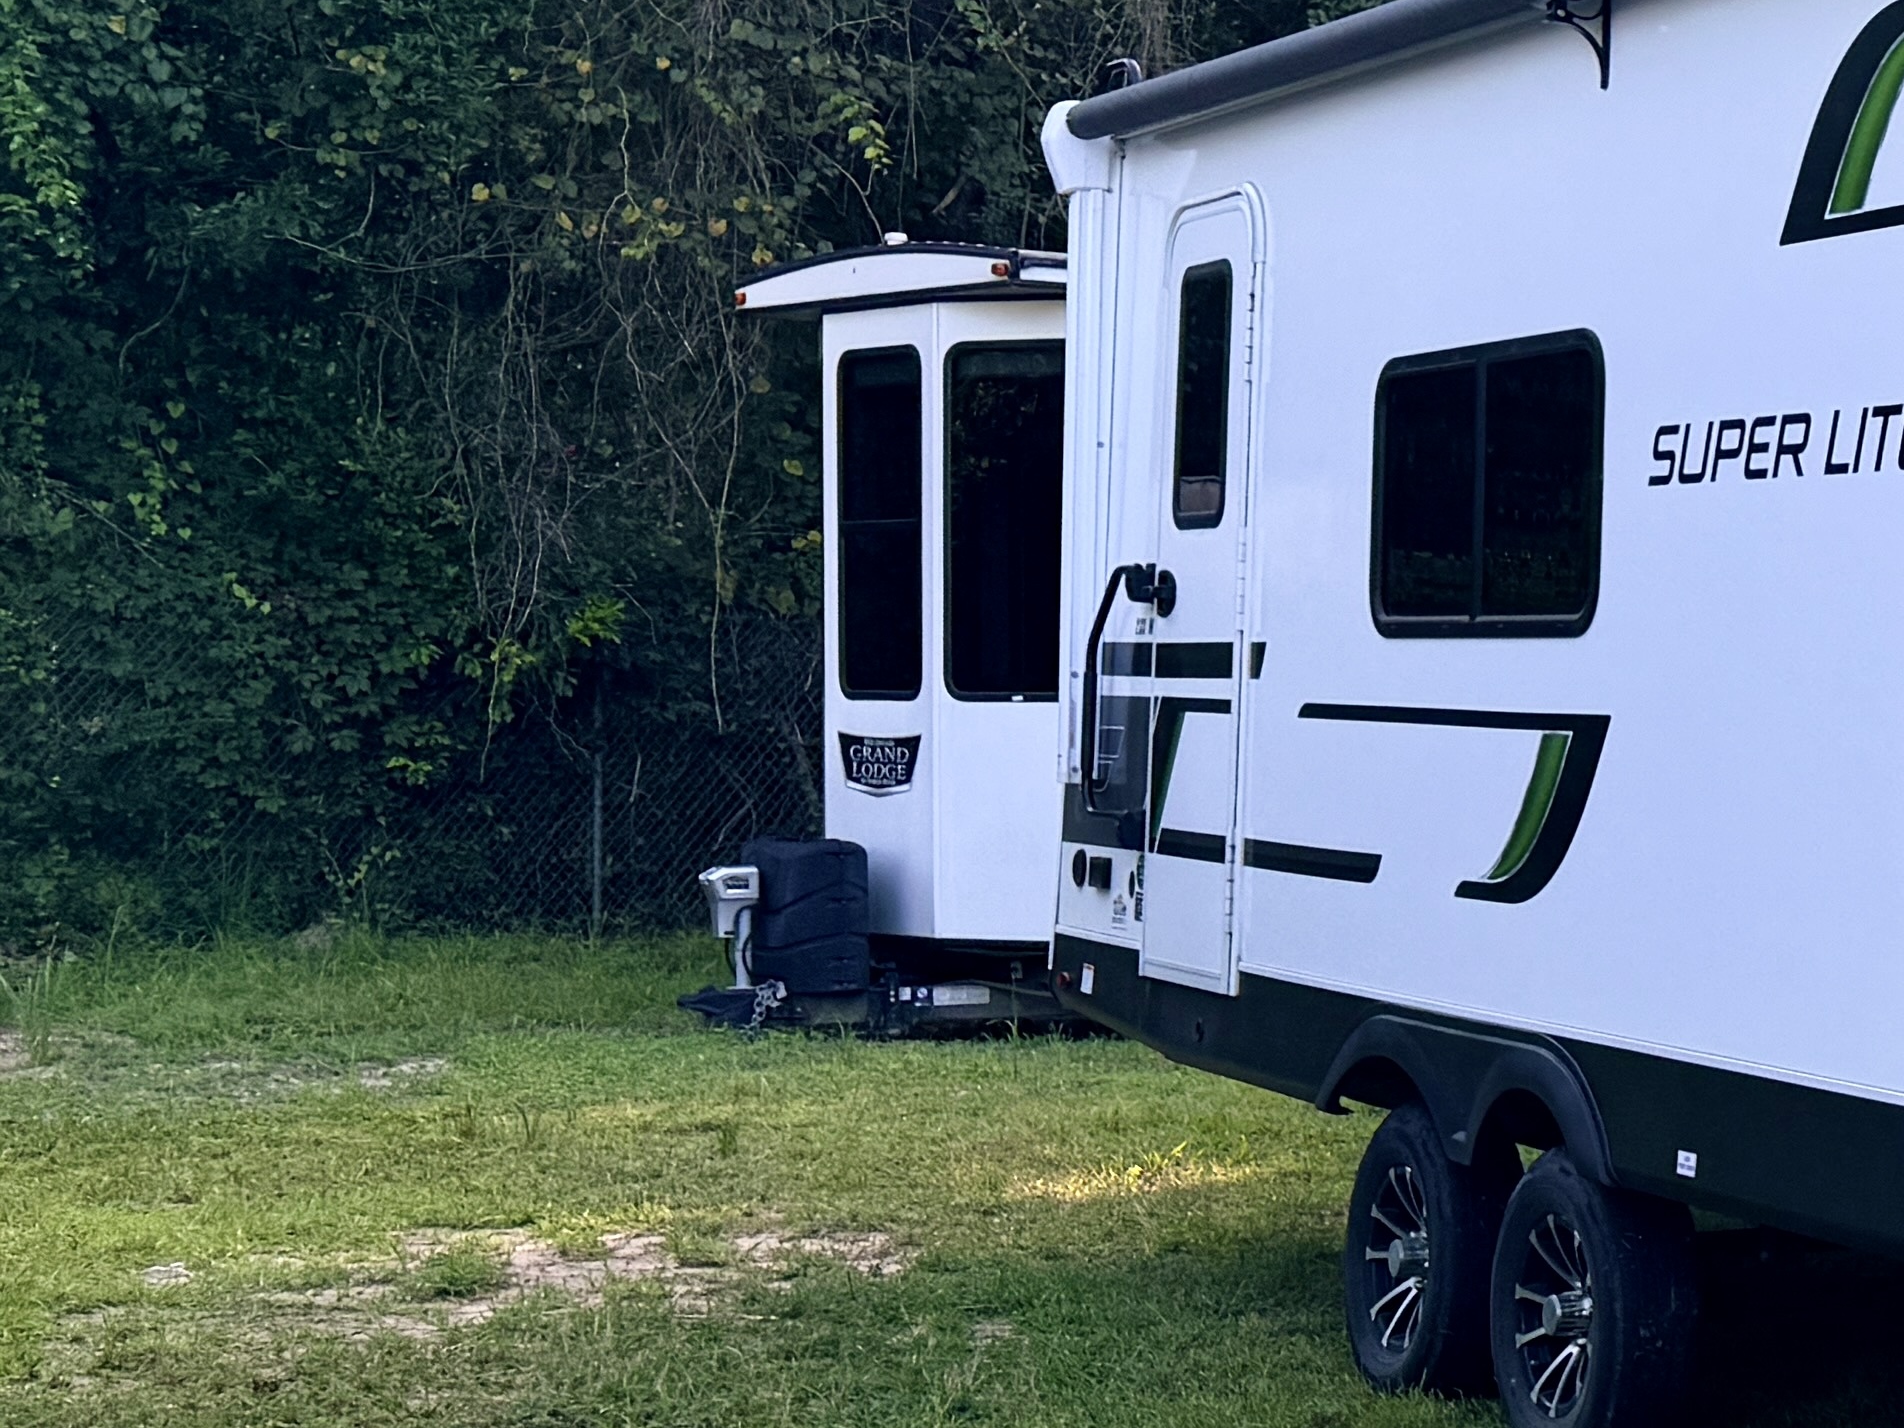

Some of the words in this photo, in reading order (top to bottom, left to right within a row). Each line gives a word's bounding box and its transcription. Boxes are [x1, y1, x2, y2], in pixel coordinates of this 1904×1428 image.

[1648, 412, 1812, 487] SUPER
[849, 744, 910, 764] GRAND
[852, 761, 907, 781] LODGE
